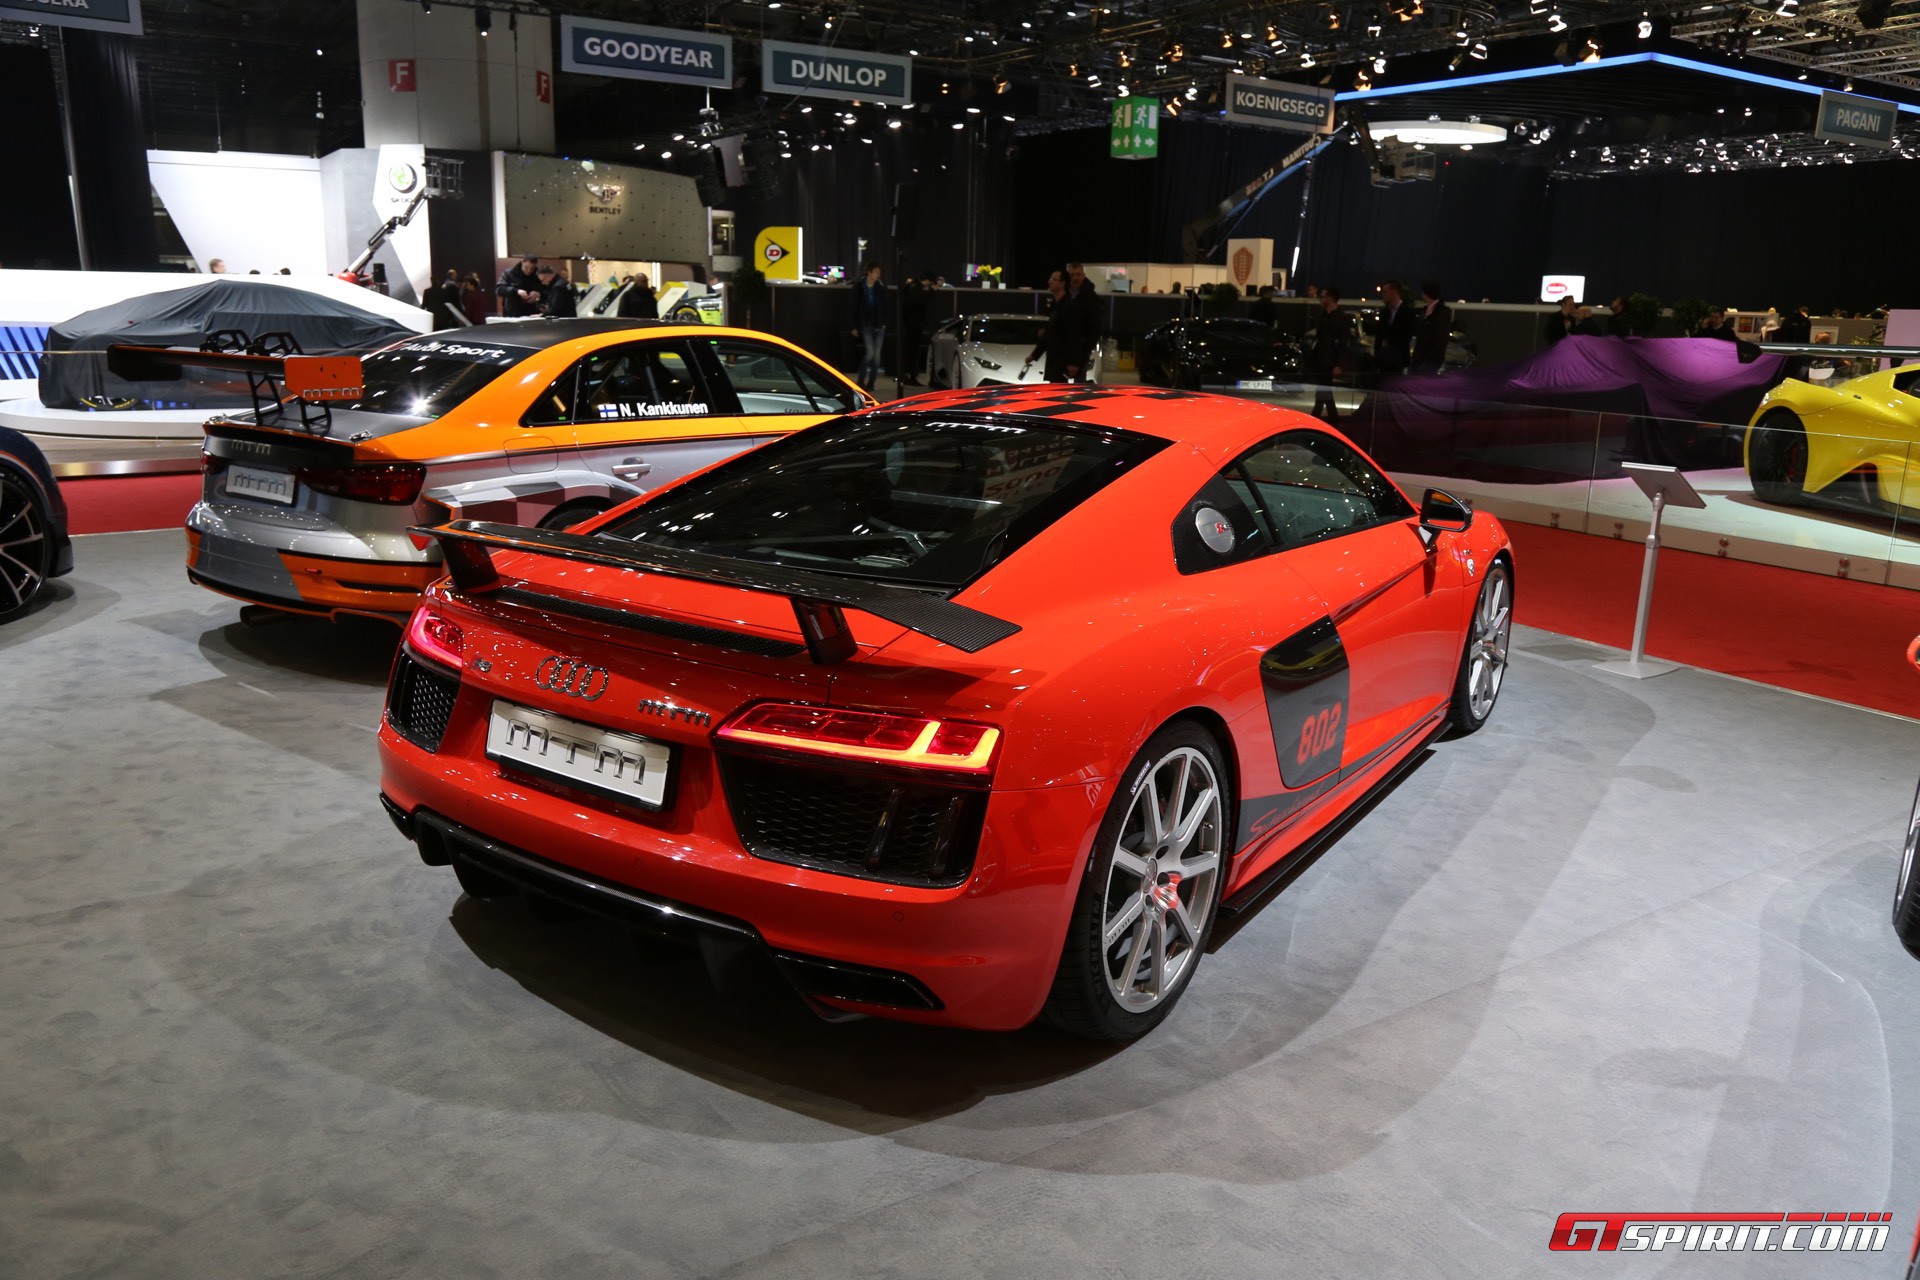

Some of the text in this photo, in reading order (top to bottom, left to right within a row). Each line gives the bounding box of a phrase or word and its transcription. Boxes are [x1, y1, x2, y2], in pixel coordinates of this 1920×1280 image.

[583, 36, 715, 69] GOODYEAR
[396, 62, 409, 84] F
[790, 59, 888, 87] DUNLOP
[540, 75, 548, 95] F
[1236, 91, 1326, 118] KOENIGSEGG
[1836, 108, 1881, 132] PAGANI
[589, 206, 622, 215] BENTLEY
[400, 341, 506, 358] Audi Sport
[619, 401, 709, 417] N. Kankkunen
[1297, 702, 1343, 765] 802
